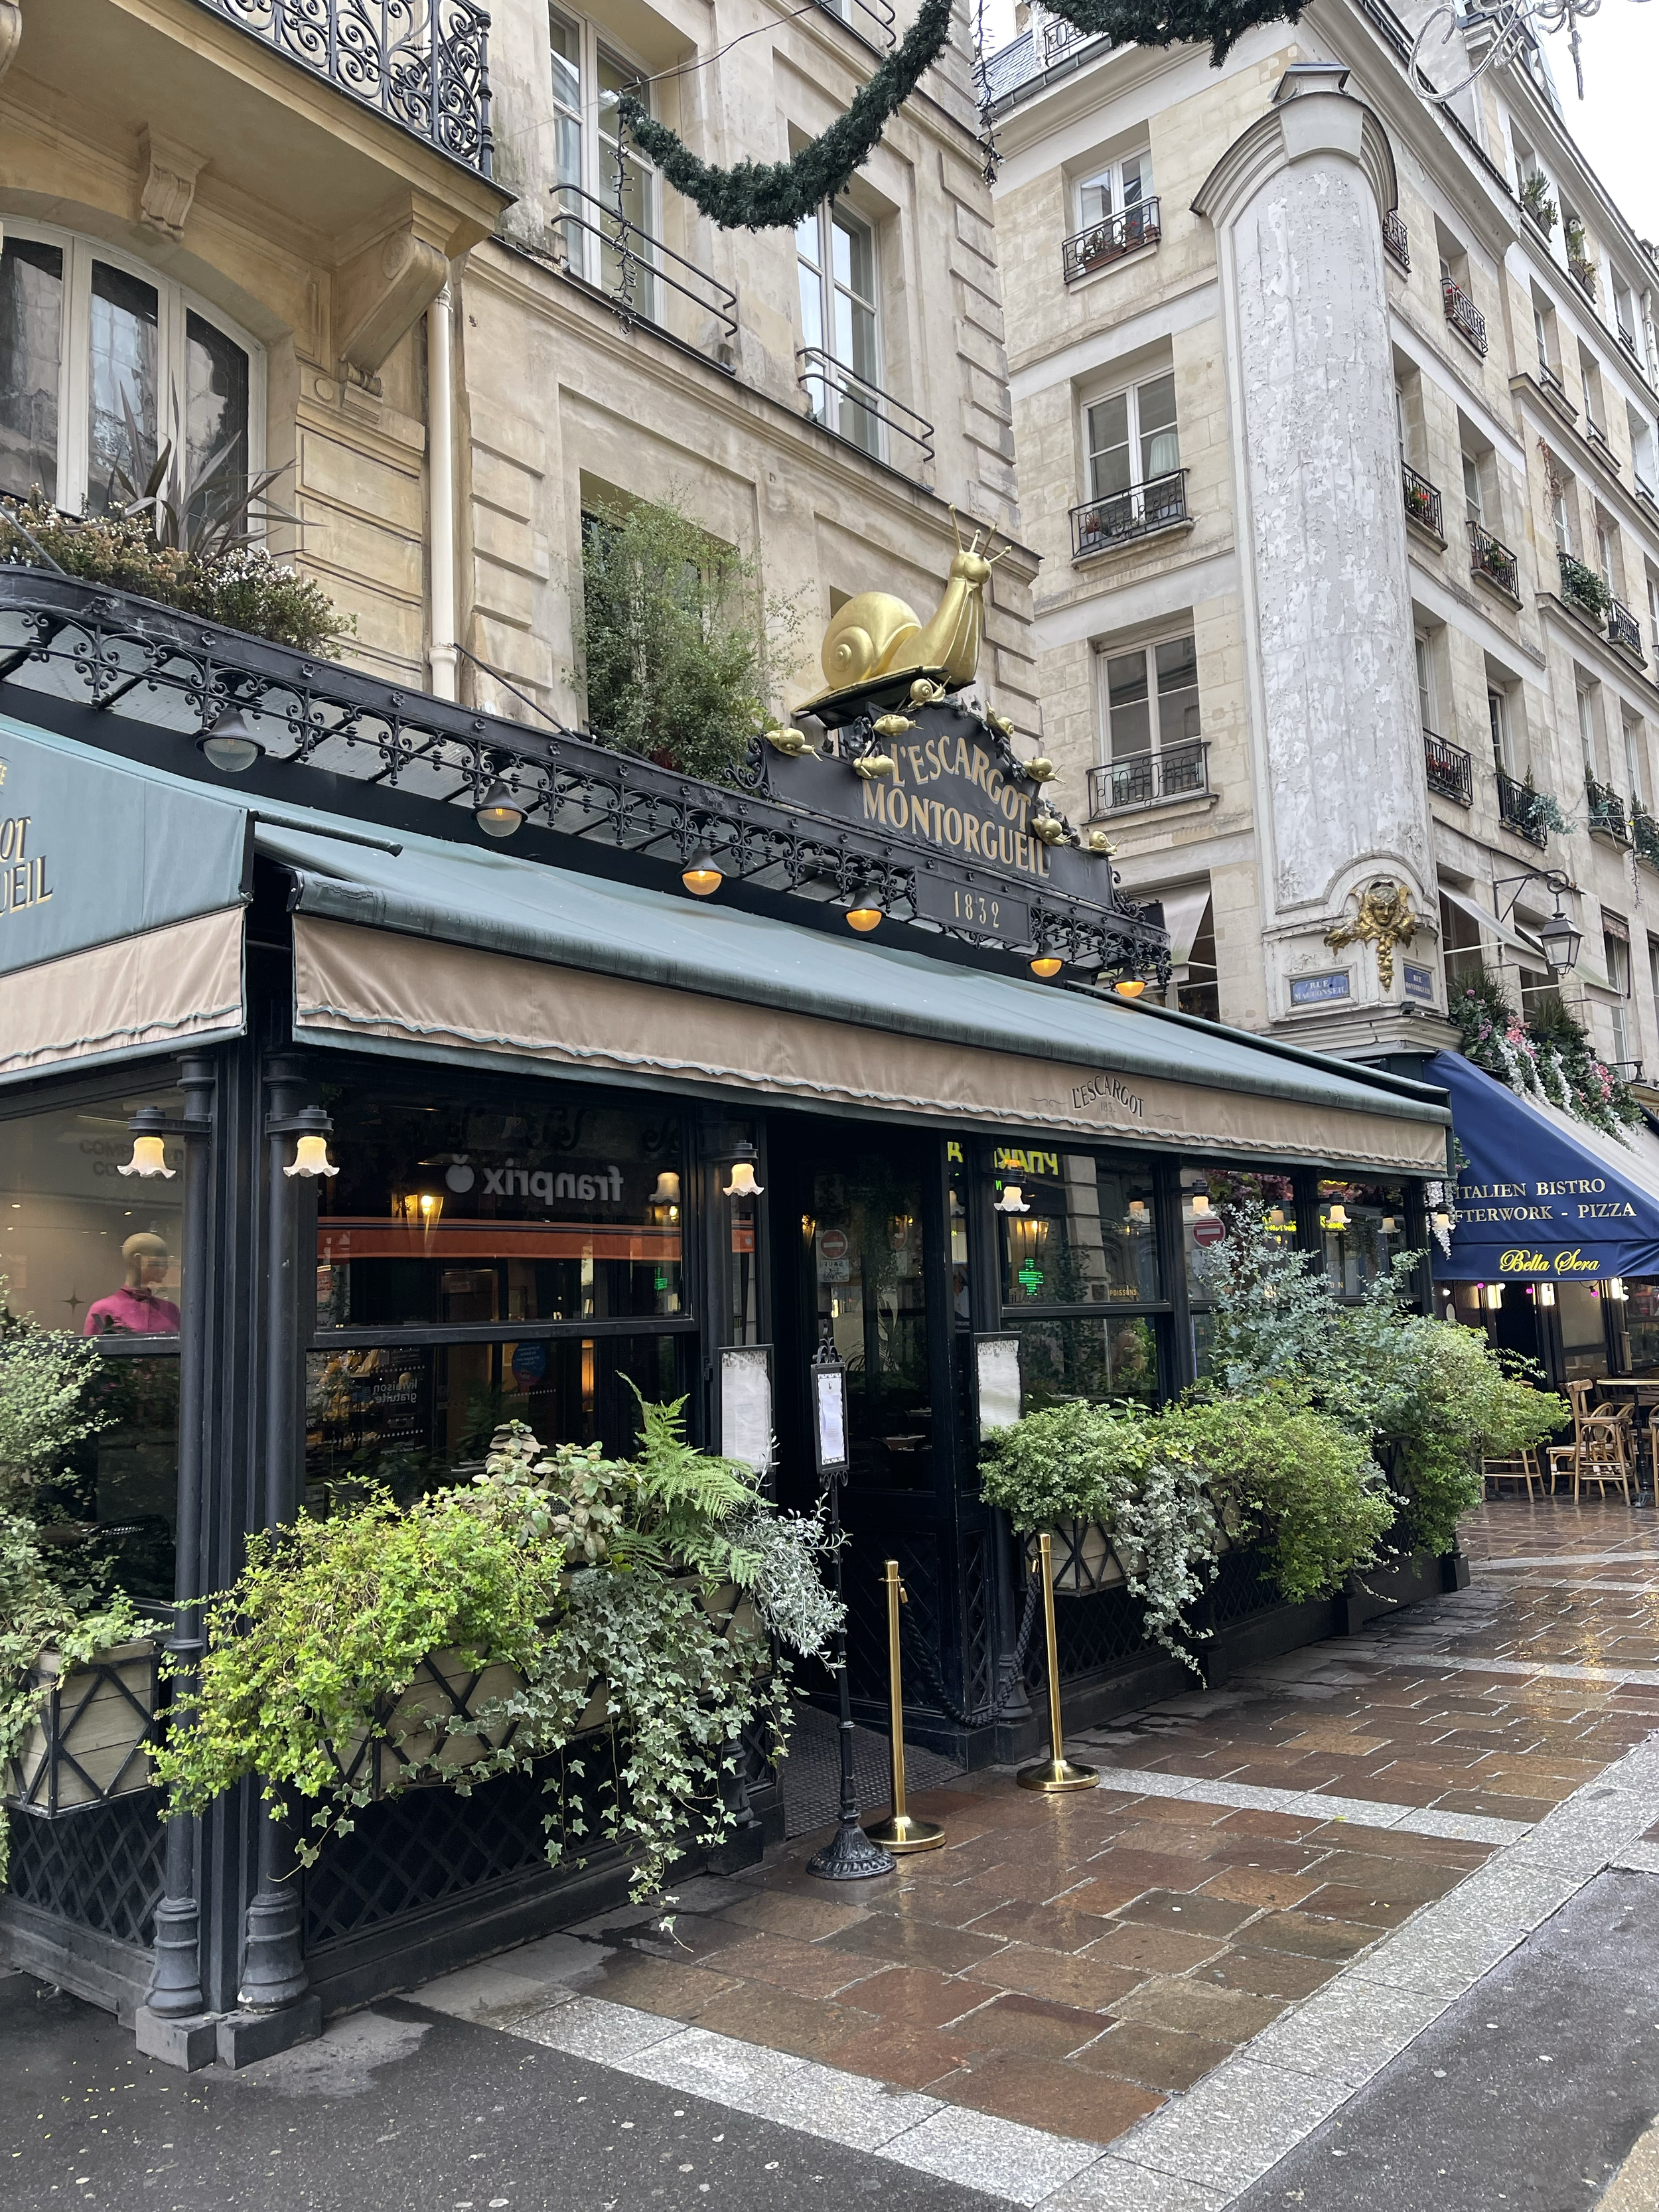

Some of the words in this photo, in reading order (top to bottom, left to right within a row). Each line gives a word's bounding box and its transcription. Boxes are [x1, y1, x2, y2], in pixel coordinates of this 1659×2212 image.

[890, 735, 1031, 834] L'ESCARGOT
[863, 778, 1052, 879] MONTORGUEIL
[954, 890, 1000, 928] 1832
[1294, 986, 1346, 1000] MAUCONSEIL
[1310, 980, 1329, 989] RUE
[1071, 1076, 1144, 1119] L'ESCARGOT
[1100, 1101, 1116, 1112] 1832
[1536, 1178, 1606, 1197] BISTRO
[1455, 1205, 1553, 1223] FTERWORK
[1577, 1202, 1637, 1218] PIZZA
[1499, 1248, 1550, 1272] Bella
[1553, 1248, 1601, 1276] Sera
